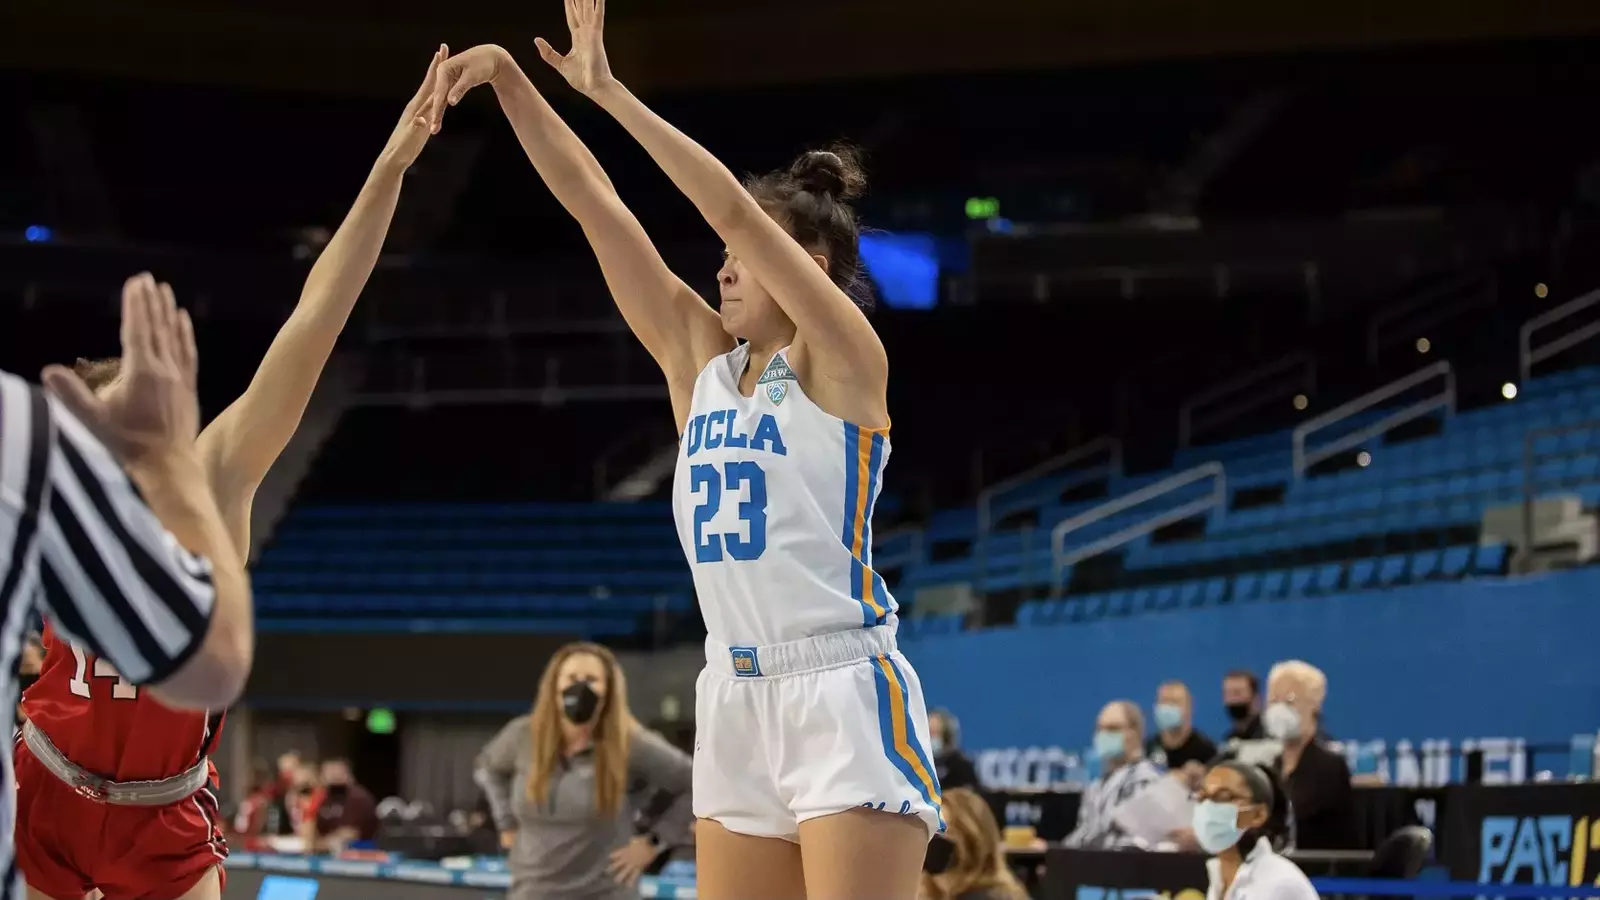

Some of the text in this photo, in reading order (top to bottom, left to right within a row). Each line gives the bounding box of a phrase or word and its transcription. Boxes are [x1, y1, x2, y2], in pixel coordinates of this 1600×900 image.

[764, 368, 788, 379] JRW
[687, 409, 787, 458] UCLA
[690, 461, 767, 563] 23
